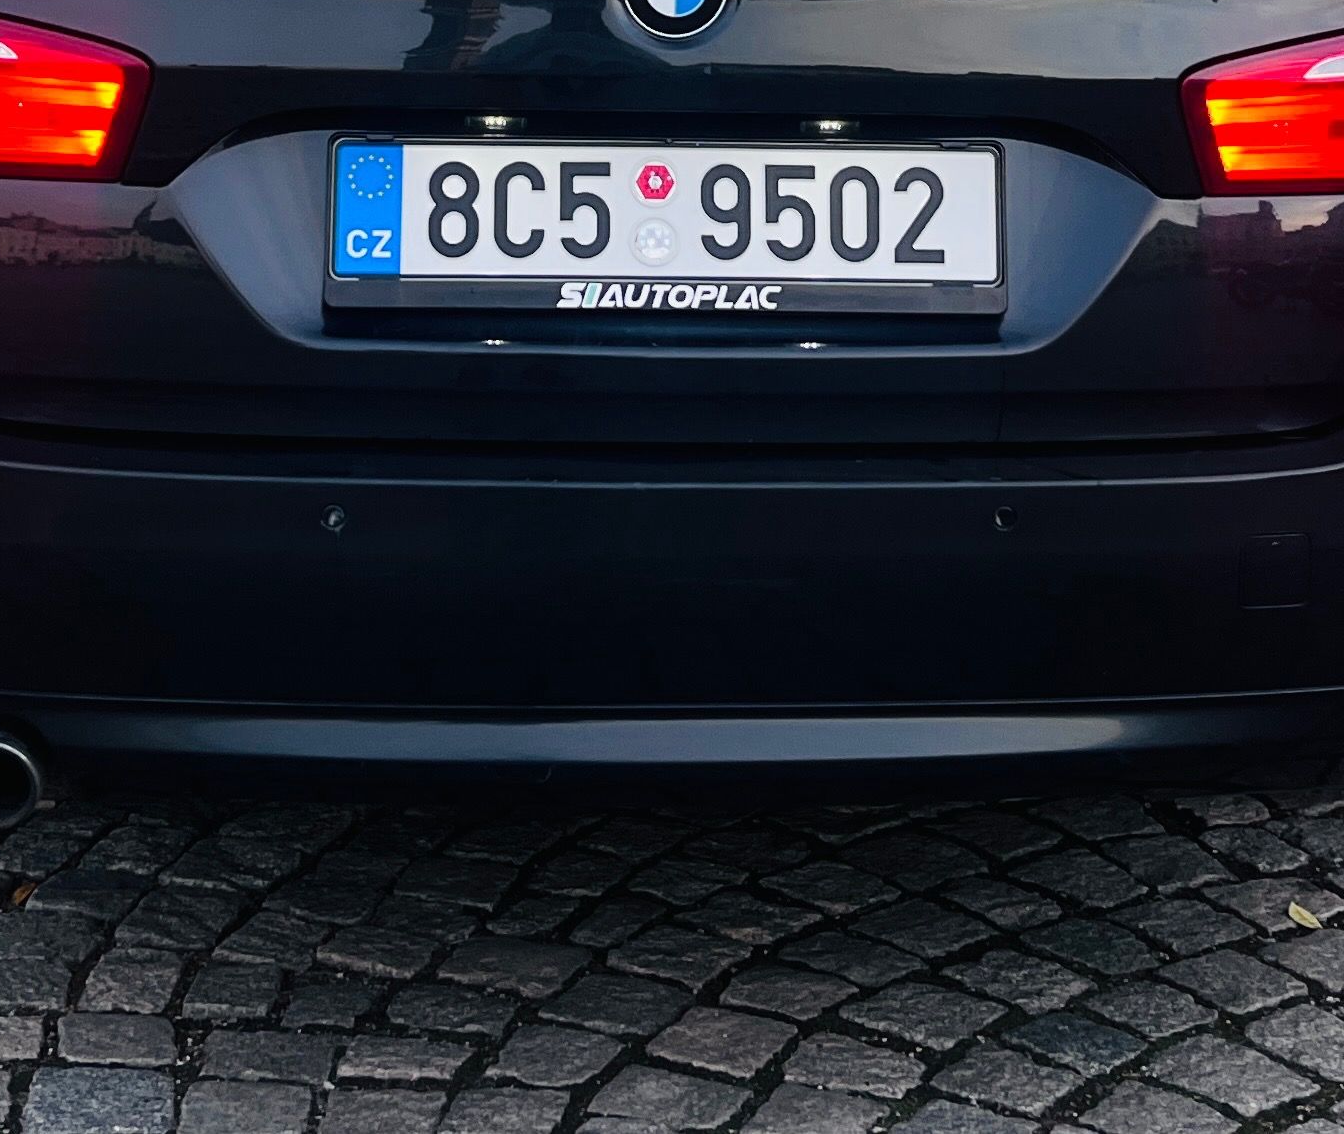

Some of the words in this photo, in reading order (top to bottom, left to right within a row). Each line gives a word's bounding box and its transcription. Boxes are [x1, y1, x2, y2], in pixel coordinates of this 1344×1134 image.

[345, 230, 393, 260] CZ
[427, 160, 613, 260] 8C5
[699, 163, 946, 265] 9502
